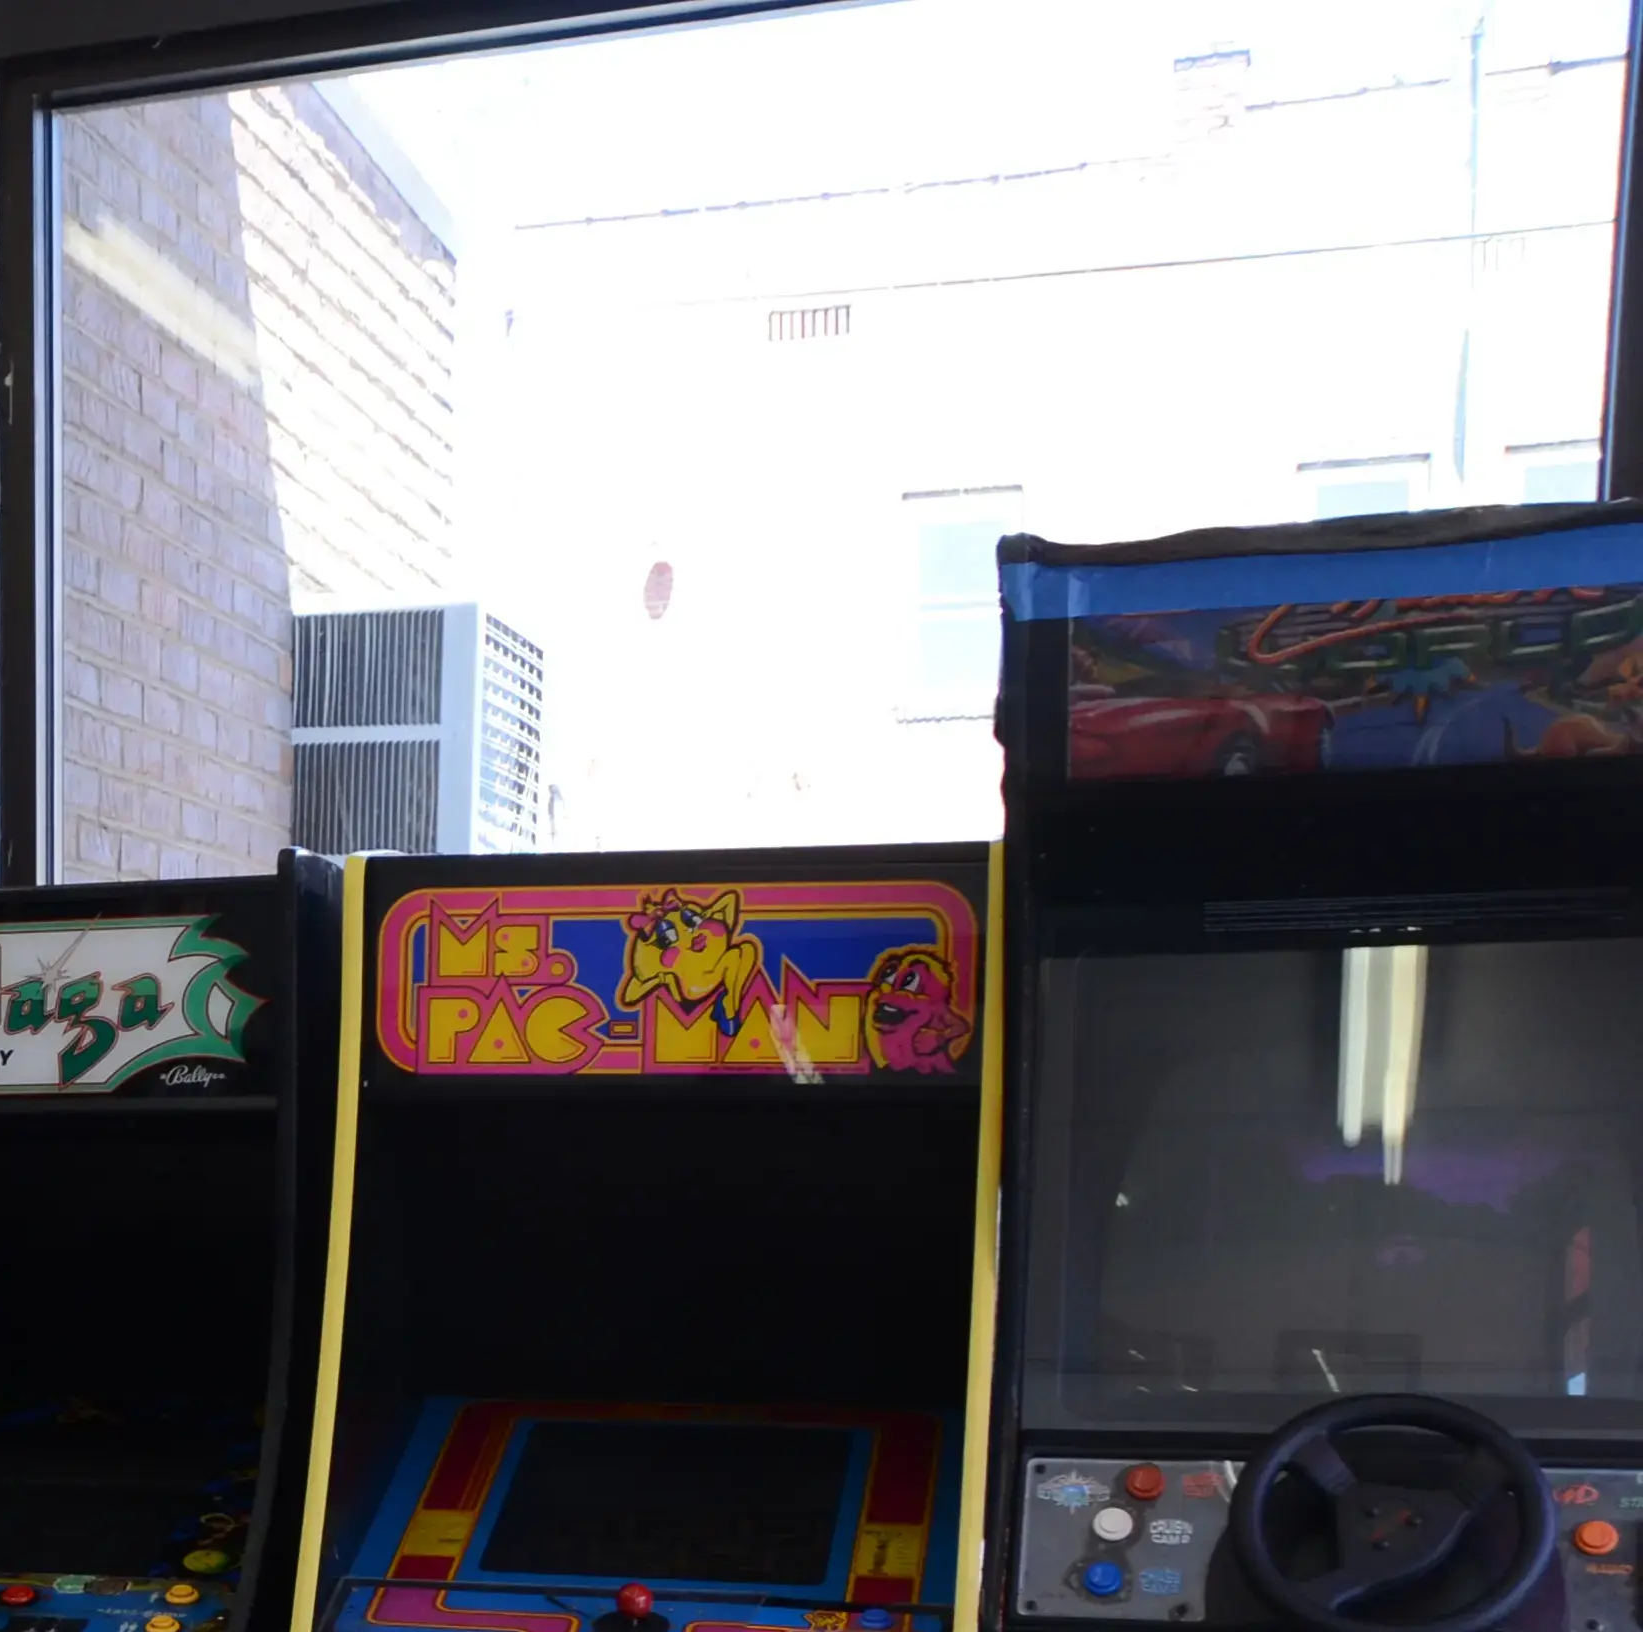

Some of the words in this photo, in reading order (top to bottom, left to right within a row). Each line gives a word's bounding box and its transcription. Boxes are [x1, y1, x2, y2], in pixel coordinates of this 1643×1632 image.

[433, 903, 573, 981] MS.
[422, 987, 864, 1068] PAC-MAN
[165, 1064, 213, 1088] Bally
